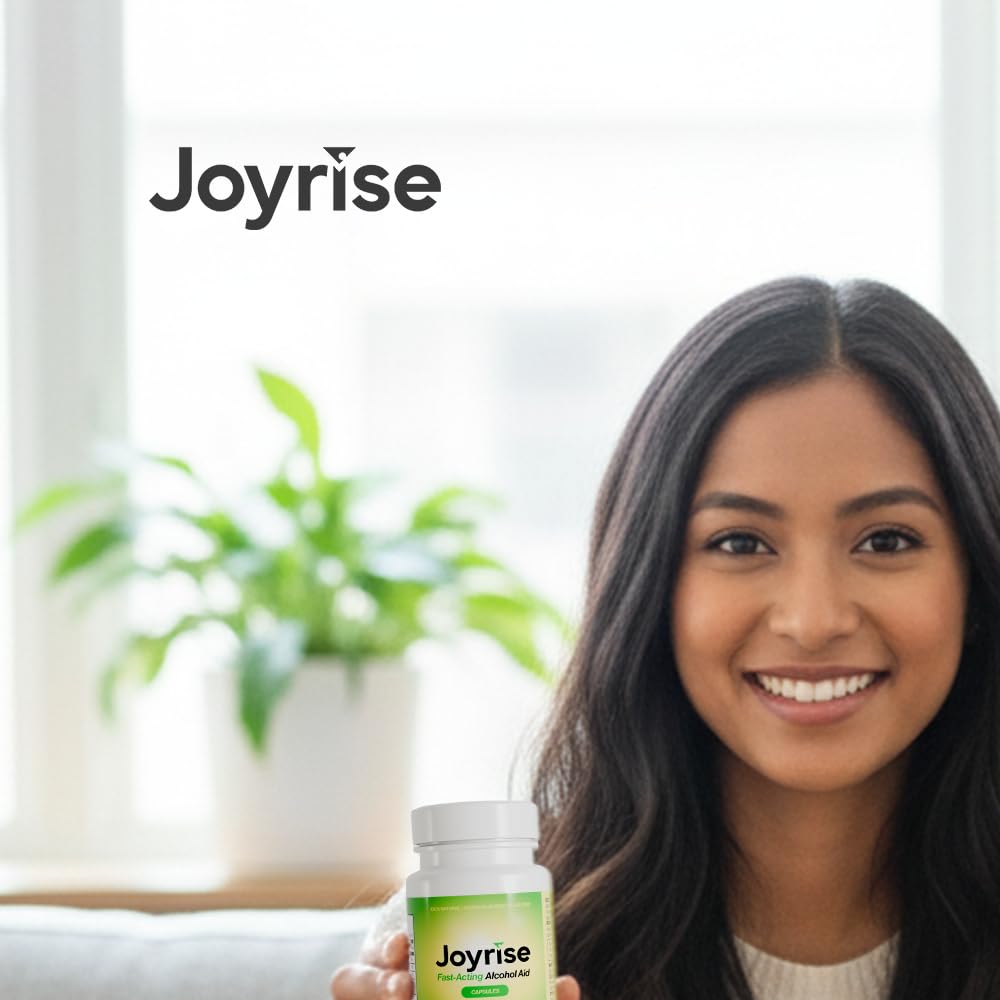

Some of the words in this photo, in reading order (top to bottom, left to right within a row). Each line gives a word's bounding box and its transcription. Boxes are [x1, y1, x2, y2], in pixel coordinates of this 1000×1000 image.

[436, 942, 531, 973] Joyrise
[437, 973, 483, 982] Fast-Acting
[485, 970, 517, 980] Alcohol
[517, 968, 531, 978] Aid
